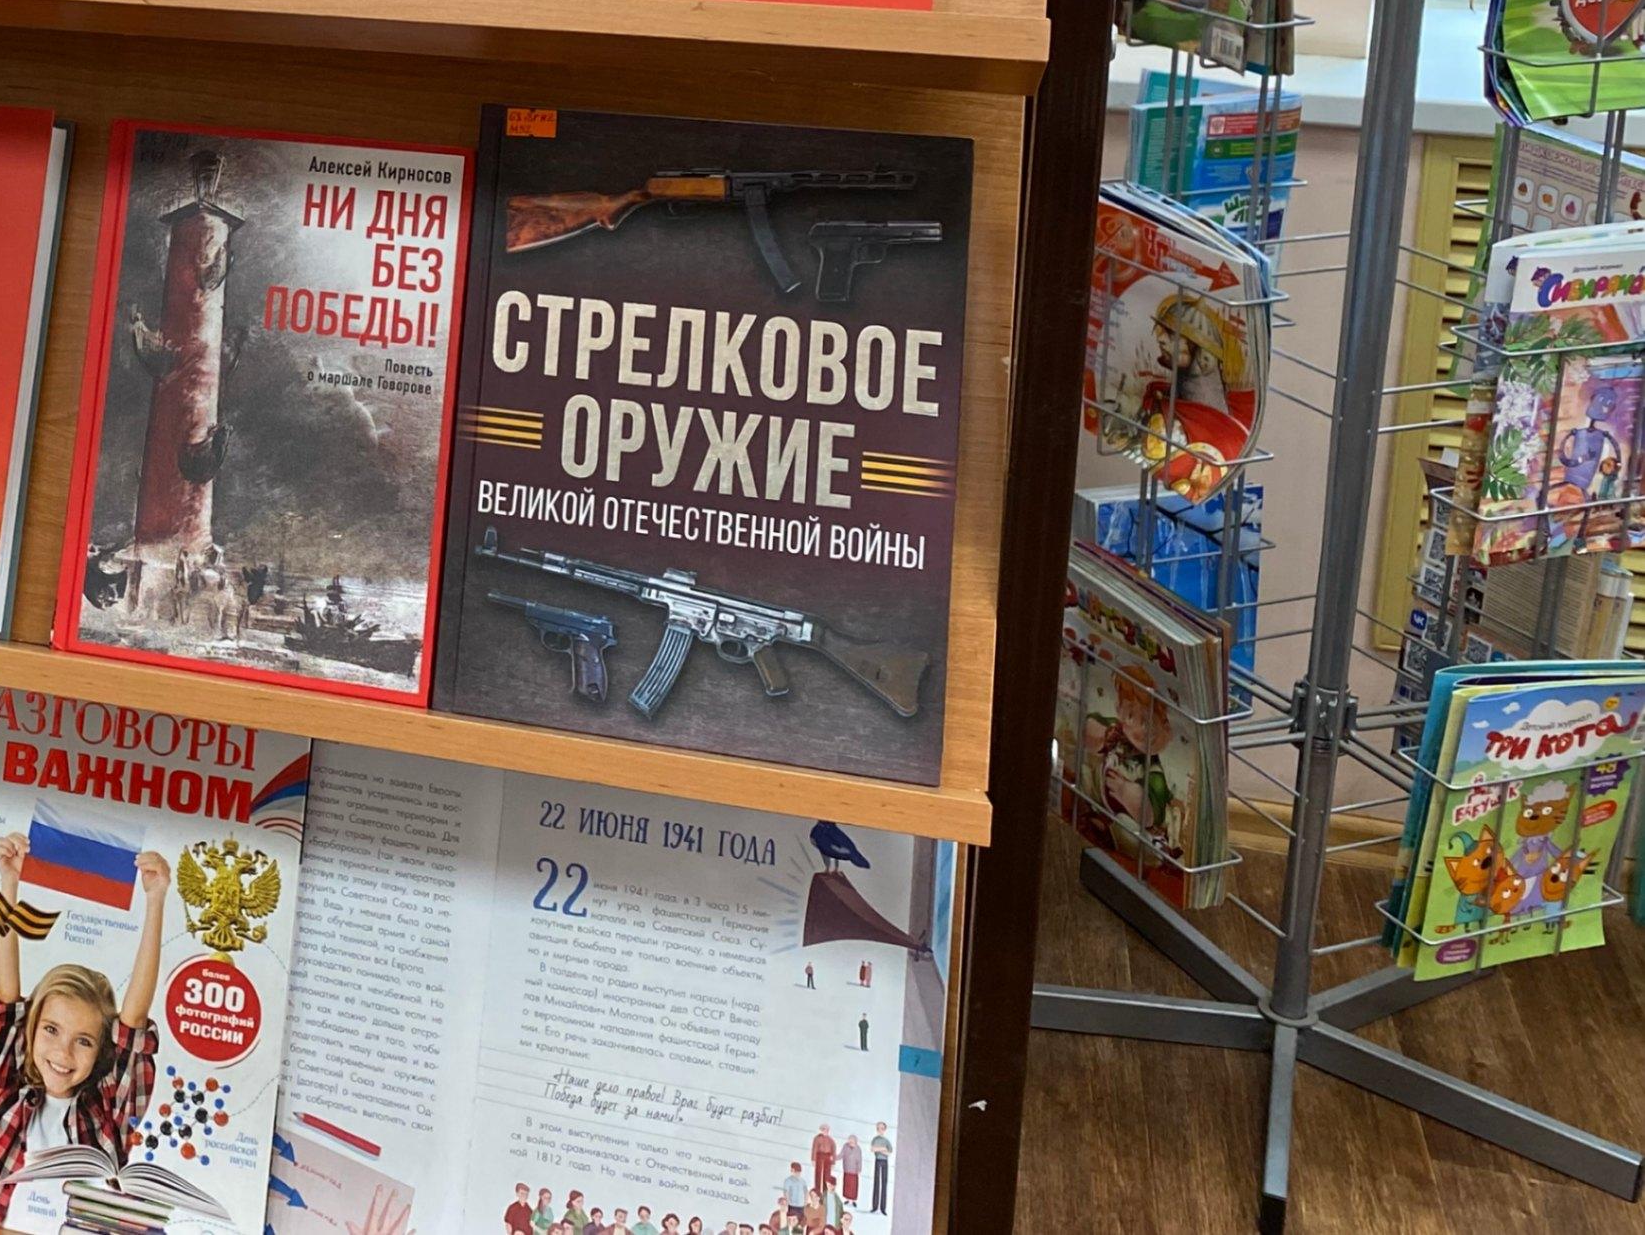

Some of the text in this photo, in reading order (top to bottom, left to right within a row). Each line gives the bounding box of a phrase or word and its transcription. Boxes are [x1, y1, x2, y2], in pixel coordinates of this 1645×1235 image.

[308, 155, 452, 185] Алексей Кирносов
[302, 183, 448, 241] НИ ДНЯ
[371, 243, 444, 294] БЕЗ
[263, 286, 439, 349] ПОБЕДЫ!
[492, 290, 944, 418] СТРЕЛКОВОЕ
[385, 359, 434, 378] Повесть
[307, 371, 432, 395] о маршале Говорове
[560, 394, 855, 509] ОРУЖИЕ
[477, 480, 925, 570] ВЕЛИКОЙ ОТЕЧЕСТВЕННОЙ ВОЙНЫ
[1485, 712, 1639, 760] ТРИ КОТА
[3, 740, 255, 825] ВАЖНОМ
[539, 800, 777, 867] 22 ИЮНЯ 1941 ГОДА
[531, 857, 590, 919] 22
[624, 883, 648, 897] 1941
[66, 910, 139, 933] Государственные
[652, 905, 712, 925] фашистская
[64, 932, 95, 946] России
[652, 920, 705, 939] Советский
[202, 968, 231, 981] более
[184, 977, 245, 1013] 300
[175, 1004, 255, 1028] фотографий
[179, 1020, 243, 1045] РОССИИ
[544, 1082, 582, 1109] Победа
[590, 1092, 618, 1115] будет
[625, 1104, 638, 1120] за
[553, 1067, 784, 1128] «Наше дело правое! Враг будет разбит!
[204, 1139, 258, 1157] российской
[235, 1132, 259, 1145] День
[229, 1156, 257, 1170] науки
[536, 1151, 561, 1166] 1812
[645, 1157, 724, 1183] Отечественной
[27, 1191, 51, 1204] День
